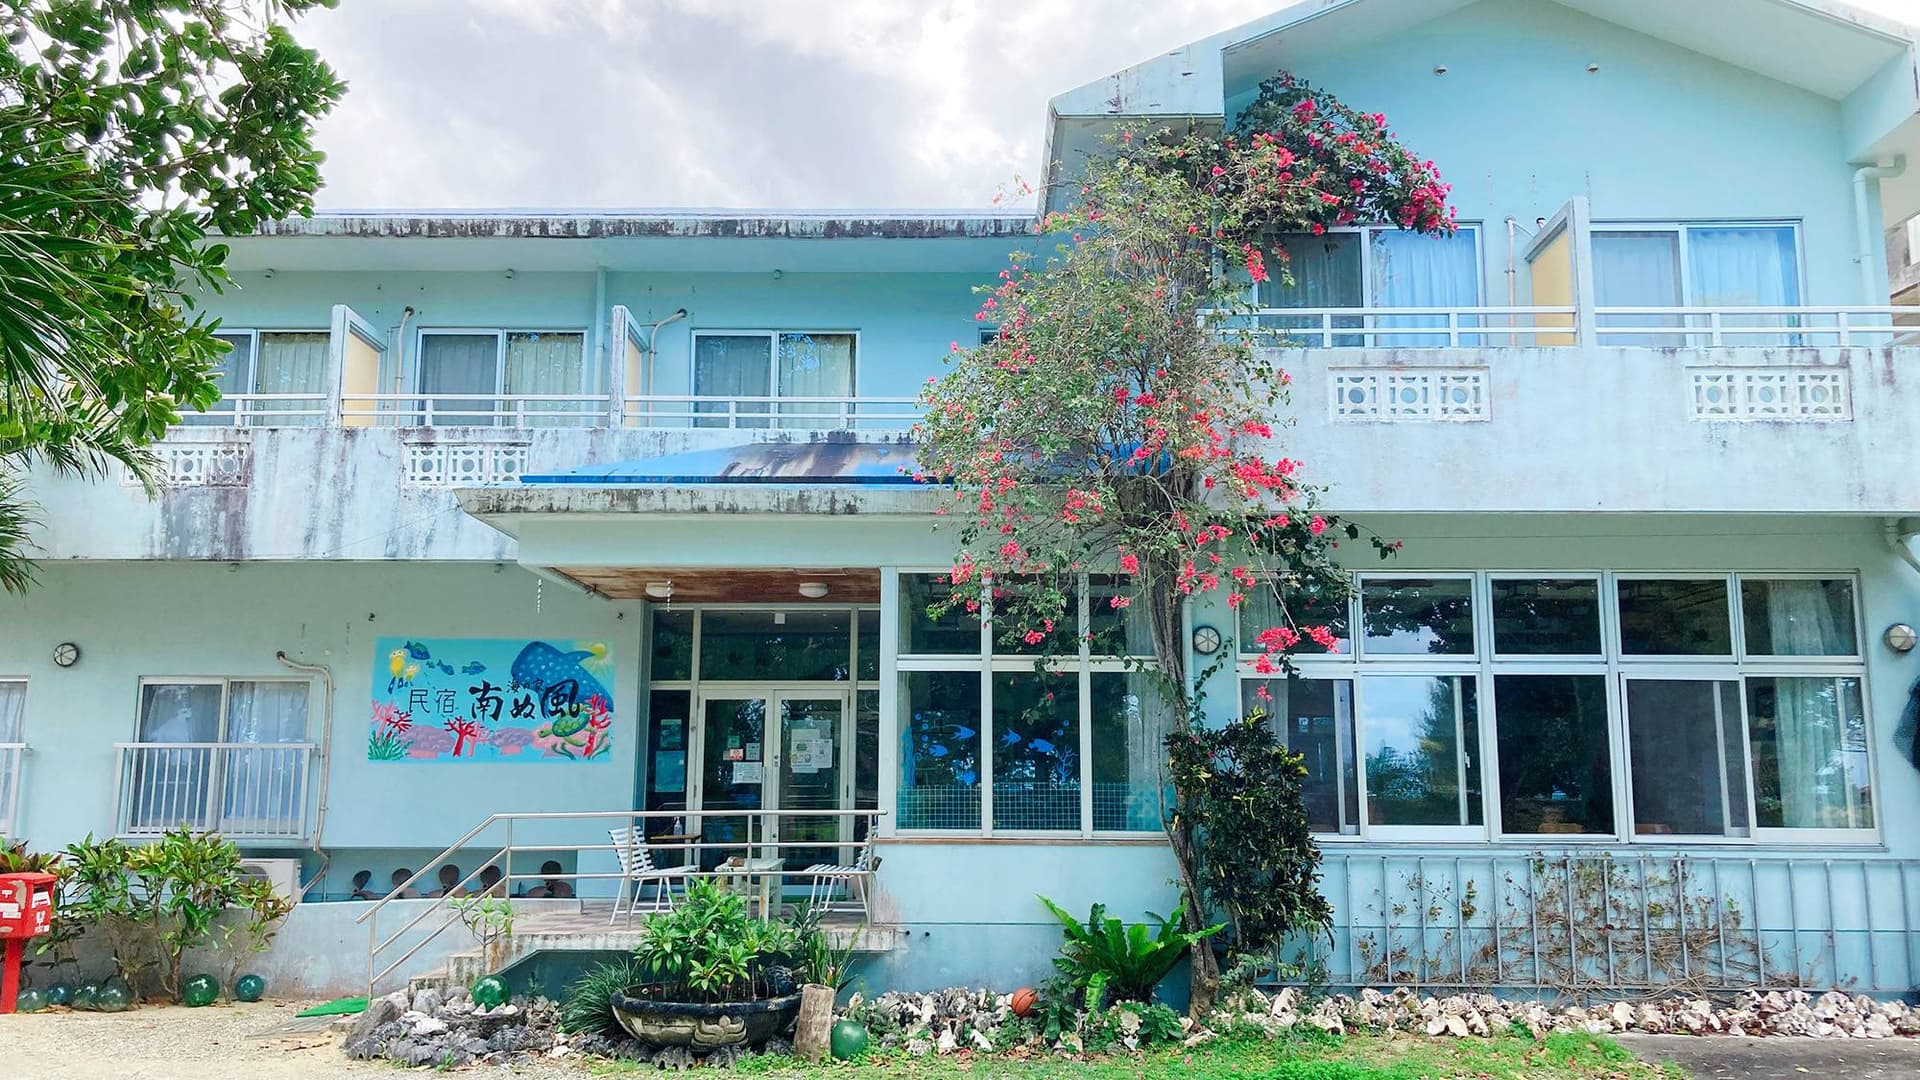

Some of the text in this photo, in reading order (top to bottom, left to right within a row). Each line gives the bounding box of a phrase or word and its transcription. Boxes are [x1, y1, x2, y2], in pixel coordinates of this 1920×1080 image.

[408, 679, 580, 721] 民宿 南ぬ風
